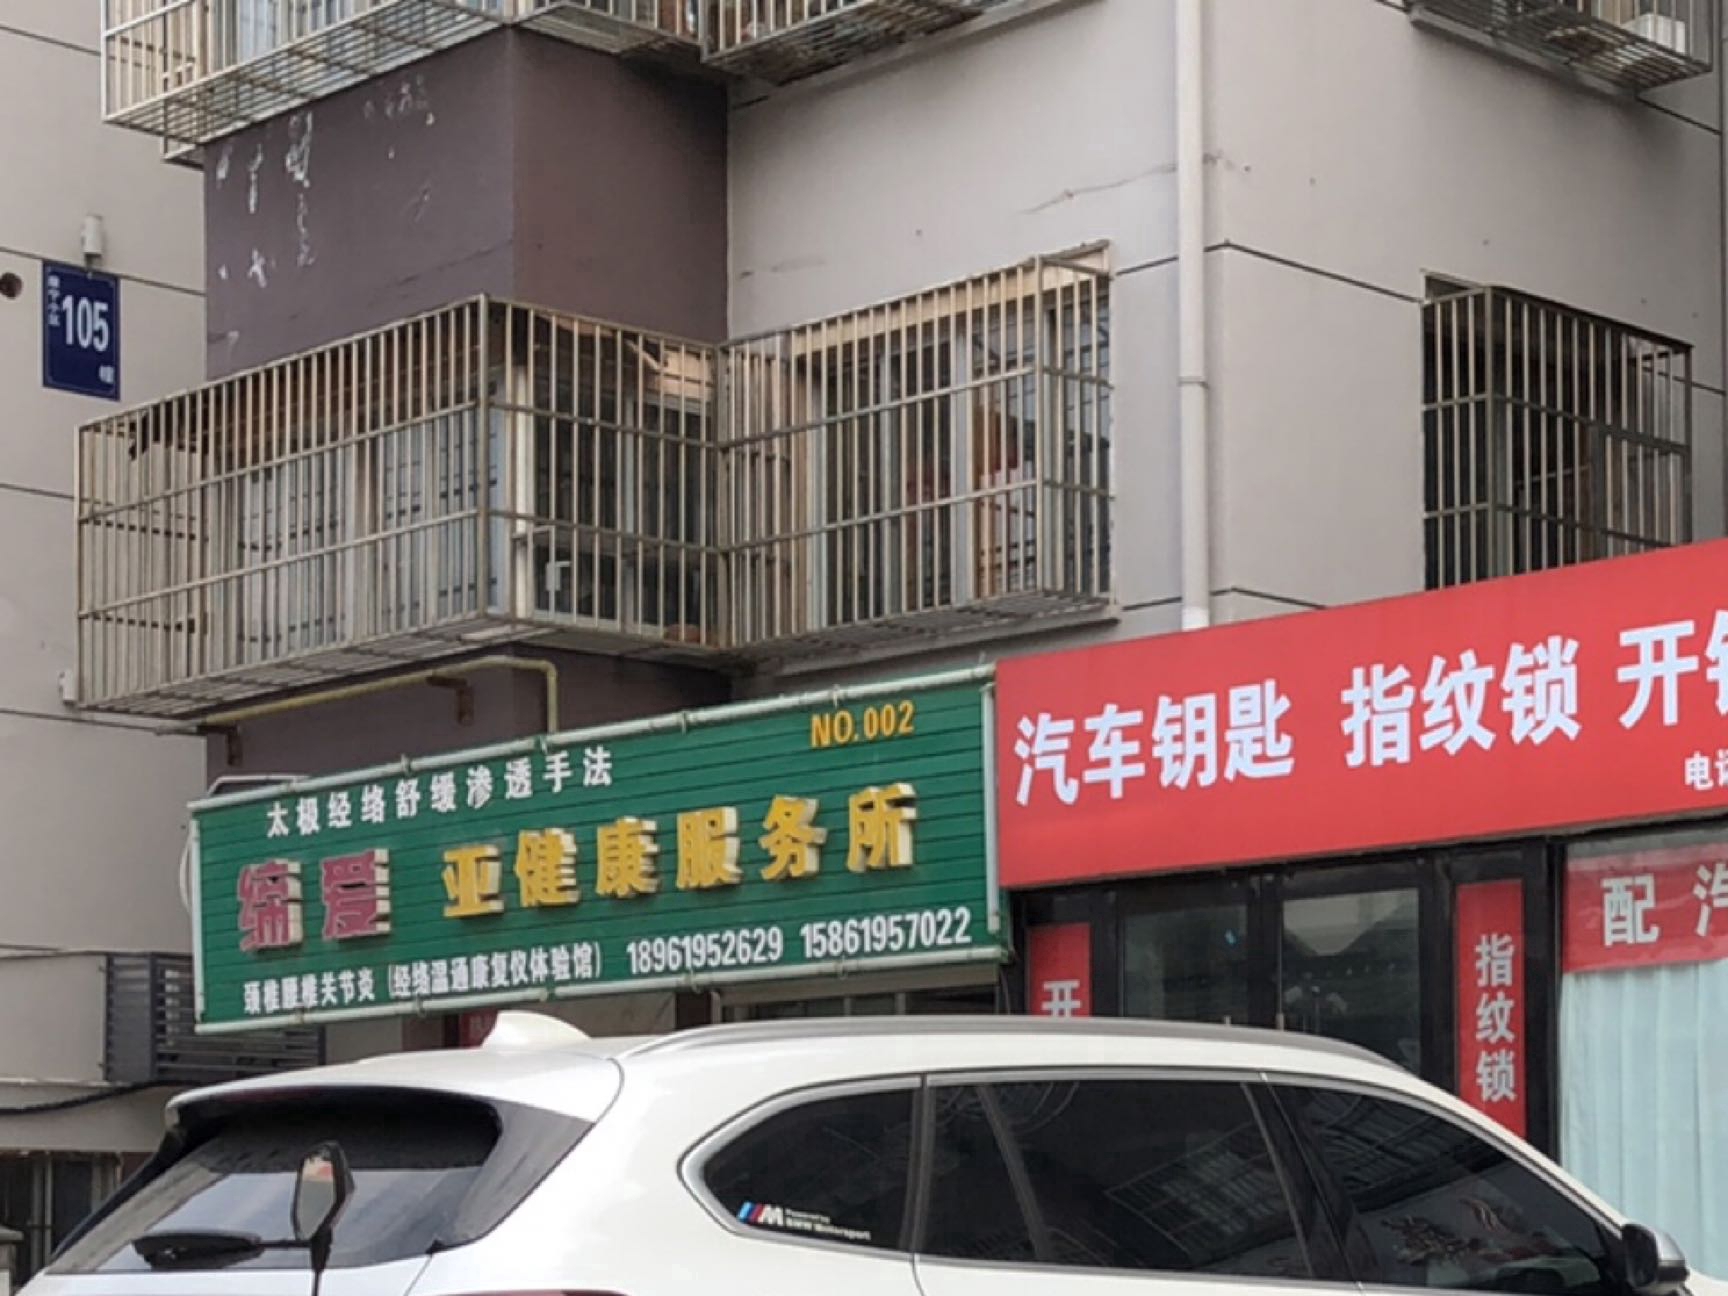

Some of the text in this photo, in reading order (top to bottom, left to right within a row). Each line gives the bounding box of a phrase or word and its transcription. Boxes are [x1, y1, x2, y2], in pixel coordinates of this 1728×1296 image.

[62, 295, 108, 351] 105
[810, 700, 915, 749] NO.002
[1014, 678, 1295, 806] 汽车钥匙
[1341, 635, 1580, 768] 指纹锁
[267, 746, 612, 839] 太极经络舒缓渗透手法
[442, 783, 917, 919] 亚健康服务所
[627, 927, 783, 974] 18961952629
[800, 906, 971, 958] 15861957022
[1475, 933, 1515, 1102] 指纹锁
